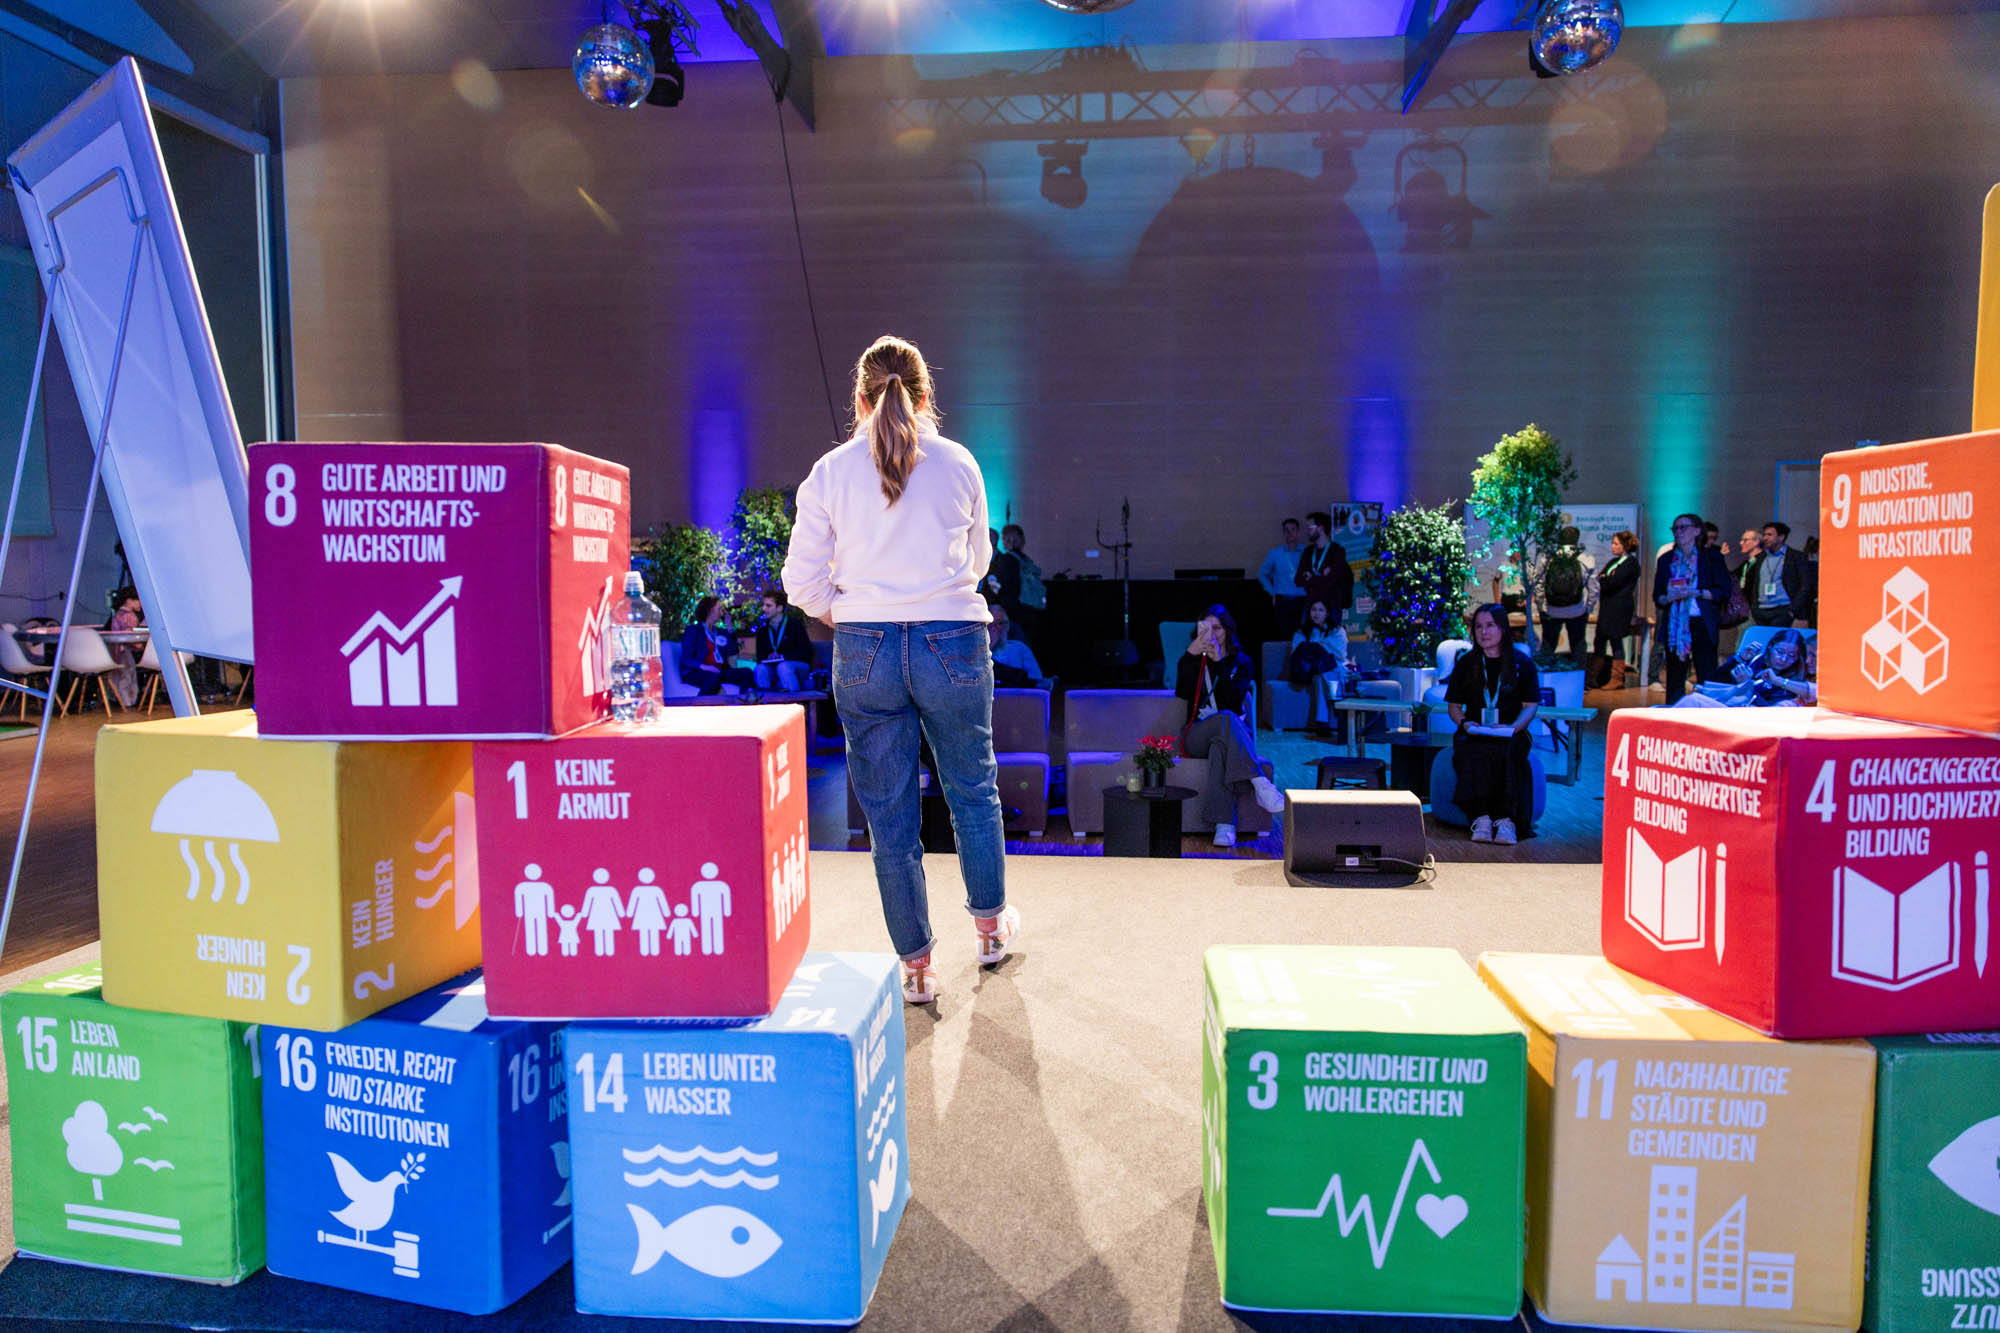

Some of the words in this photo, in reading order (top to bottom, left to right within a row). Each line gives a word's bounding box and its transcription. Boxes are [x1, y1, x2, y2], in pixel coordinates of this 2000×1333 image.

[265, 463, 296, 526] 8
[322, 464, 376, 492] GUTE
[381, 464, 458, 492] ARBEIT
[461, 465, 506, 492] UND
[555, 464, 567, 527] 8
[1860, 462, 1933, 496] INDUSTRIE,
[322, 500, 480, 527] WIRTSCHAFTS-
[1831, 474, 1852, 529] 9
[1858, 494, 1941, 527] INNOVATION
[1941, 491, 1973, 521] UND
[322, 534, 445, 562] WACHSTUM
[1858, 527, 1973, 560] INFRASTRUKTUR
[555, 759, 615, 786] KEINE
[1612, 733, 1630, 787] 4
[1636, 735, 1767, 784] CHANCENGERECHTE
[507, 761, 528, 819] 1
[558, 792, 630, 819] ARMUT
[1635, 766, 1660, 795] UND
[1661, 771, 1761, 818] HOCHWERTIGE
[1805, 759, 1837, 823] 4
[1633, 797, 1688, 835] BILDUNG
[1847, 794, 1895, 823] UND
[1845, 827, 1930, 859] BILDUNG
[375, 858, 393, 941] HUNGER
[353, 900, 371, 949] KEIN
[197, 934, 266, 967] HUNGER
[227, 970, 266, 1000] KEIN
[286, 945, 311, 1005] 2
[354, 963, 394, 998] 2
[17, 1016, 58, 1073] 15
[70, 1019, 119, 1048] LEBEN
[72, 1051, 95, 1077] AN
[97, 1053, 140, 1081] LAND
[275, 1034, 316, 1092] 16
[326, 1042, 400, 1076] FRIEDEN,
[403, 1050, 456, 1085] RECHT
[508, 1044, 540, 1112] 16
[644, 1052, 708, 1081] LEBEN
[710, 1054, 776, 1083] UNTER
[1247, 1051, 1279, 1110] 3
[1305, 1052, 1440, 1083] GESUNDHEIT
[1442, 1058, 1488, 1084] UND
[1634, 1059, 1791, 1096] NACHHALTIGE
[328, 1071, 363, 1102] UND
[364, 1077, 425, 1114] STARKE
[575, 1053, 628, 1113] 14
[644, 1087, 731, 1115] WASSER
[1304, 1085, 1464, 1117] WOHLERGEHEN
[1572, 1058, 1618, 1120] 11
[325, 1104, 449, 1148] INSTITUTIONEN
[1630, 1092, 1715, 1127] STÄDTE
[1719, 1100, 1767, 1128] UND
[1628, 1129, 1757, 1162] GEMEINDEN
[1922, 1266, 2000, 1298] SSUNG
